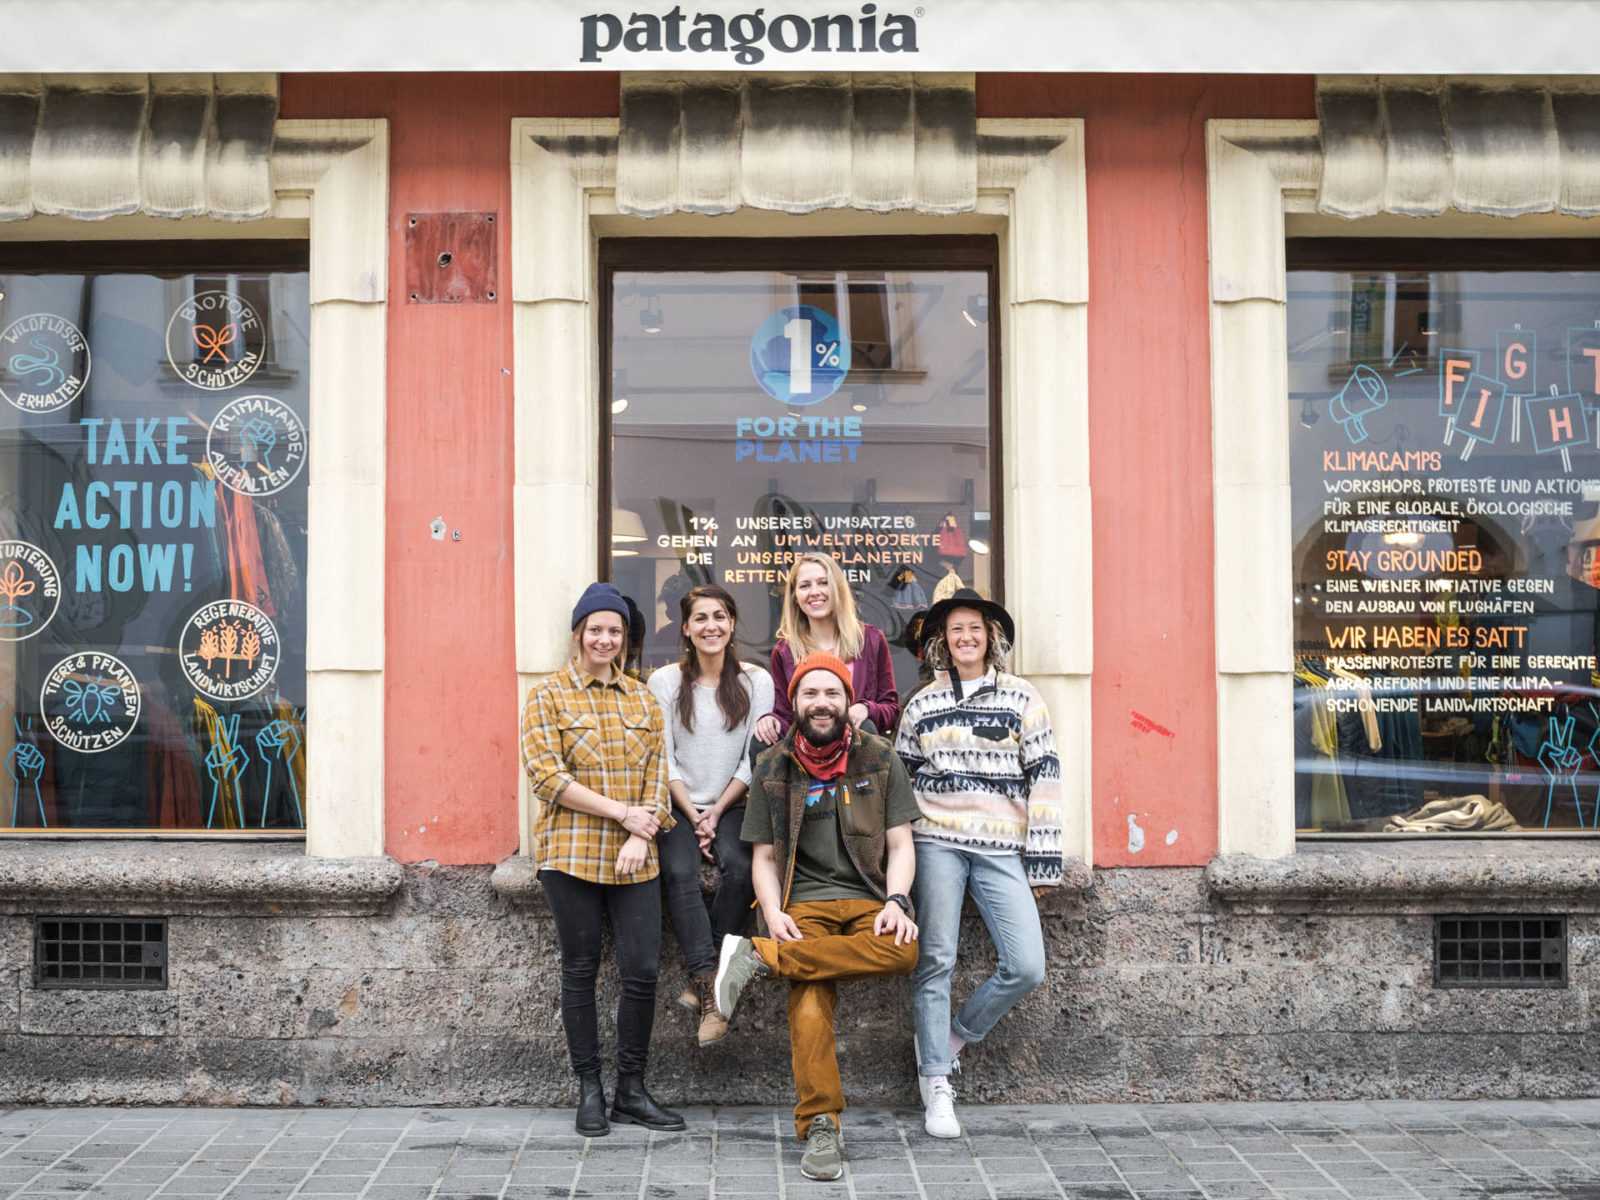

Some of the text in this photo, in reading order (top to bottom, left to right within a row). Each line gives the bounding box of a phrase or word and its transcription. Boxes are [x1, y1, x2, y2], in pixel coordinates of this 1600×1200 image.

[180, 295, 258, 332] BIOTOPE
[784, 318, 840, 394] 1%
[186, 351, 258, 388] SCHÜTZEN
[17, 375, 81, 409] ERHALTEN
[215, 400, 302, 462] KLIMAWANDEL
[736, 416, 862, 437] FOR THE
[80, 417, 189, 465] TAKE
[735, 440, 862, 462] PLANET
[211, 450, 290, 492] AUFHALTEN
[1323, 451, 1442, 471] KLIMACAMPS
[1323, 479, 1426, 495] WORKSHOPS,
[1428, 479, 1497, 493] PROTESTE
[1501, 480, 1531, 493] UND
[54, 480, 216, 529] ACTION
[1323, 497, 1573, 518] FÜR EINE GLOBALE, ÖKOLOGISCHE
[689, 515, 916, 531] 1% UNSERES UMSATZES
[1324, 520, 1460, 533] KLIMAGERECHTIGKEIT
[657, 535, 718, 547] GEHEN
[730, 535, 758, 547] AN
[75, 544, 194, 592] NOW!
[686, 552, 713, 565] DIE
[831, 551, 924, 564] PLANETEN
[1326, 550, 1483, 573] STAY GROUNDED
[725, 569, 790, 583] RETTEN
[1326, 579, 1360, 592] EINE
[1361, 579, 1422, 593] WIENER
[1507, 579, 1554, 593] GEGEN
[1325, 597, 1534, 613] DEN AUSBAU VON FLUGHÄFEN
[194, 604, 275, 645] REGENERATIVE
[1325, 626, 1528, 649] WIR HABEN ES SATT
[1325, 651, 1596, 670] MASSENPROTESTE FÜR EINE GERECHTE
[184, 653, 275, 697] LANDWIRTSCHAFT
[1325, 677, 1431, 691] AGRARREFORM
[1437, 677, 1465, 690] UND
[1468, 676, 1500, 690] EINE
[45, 660, 76, 695] TIERE
[92, 656, 137, 717] PFLANZEN
[1326, 697, 1555, 712] SCHONENDE LANDWIRTSCHAFT
[50, 716, 124, 749] SCHÜTZEN
